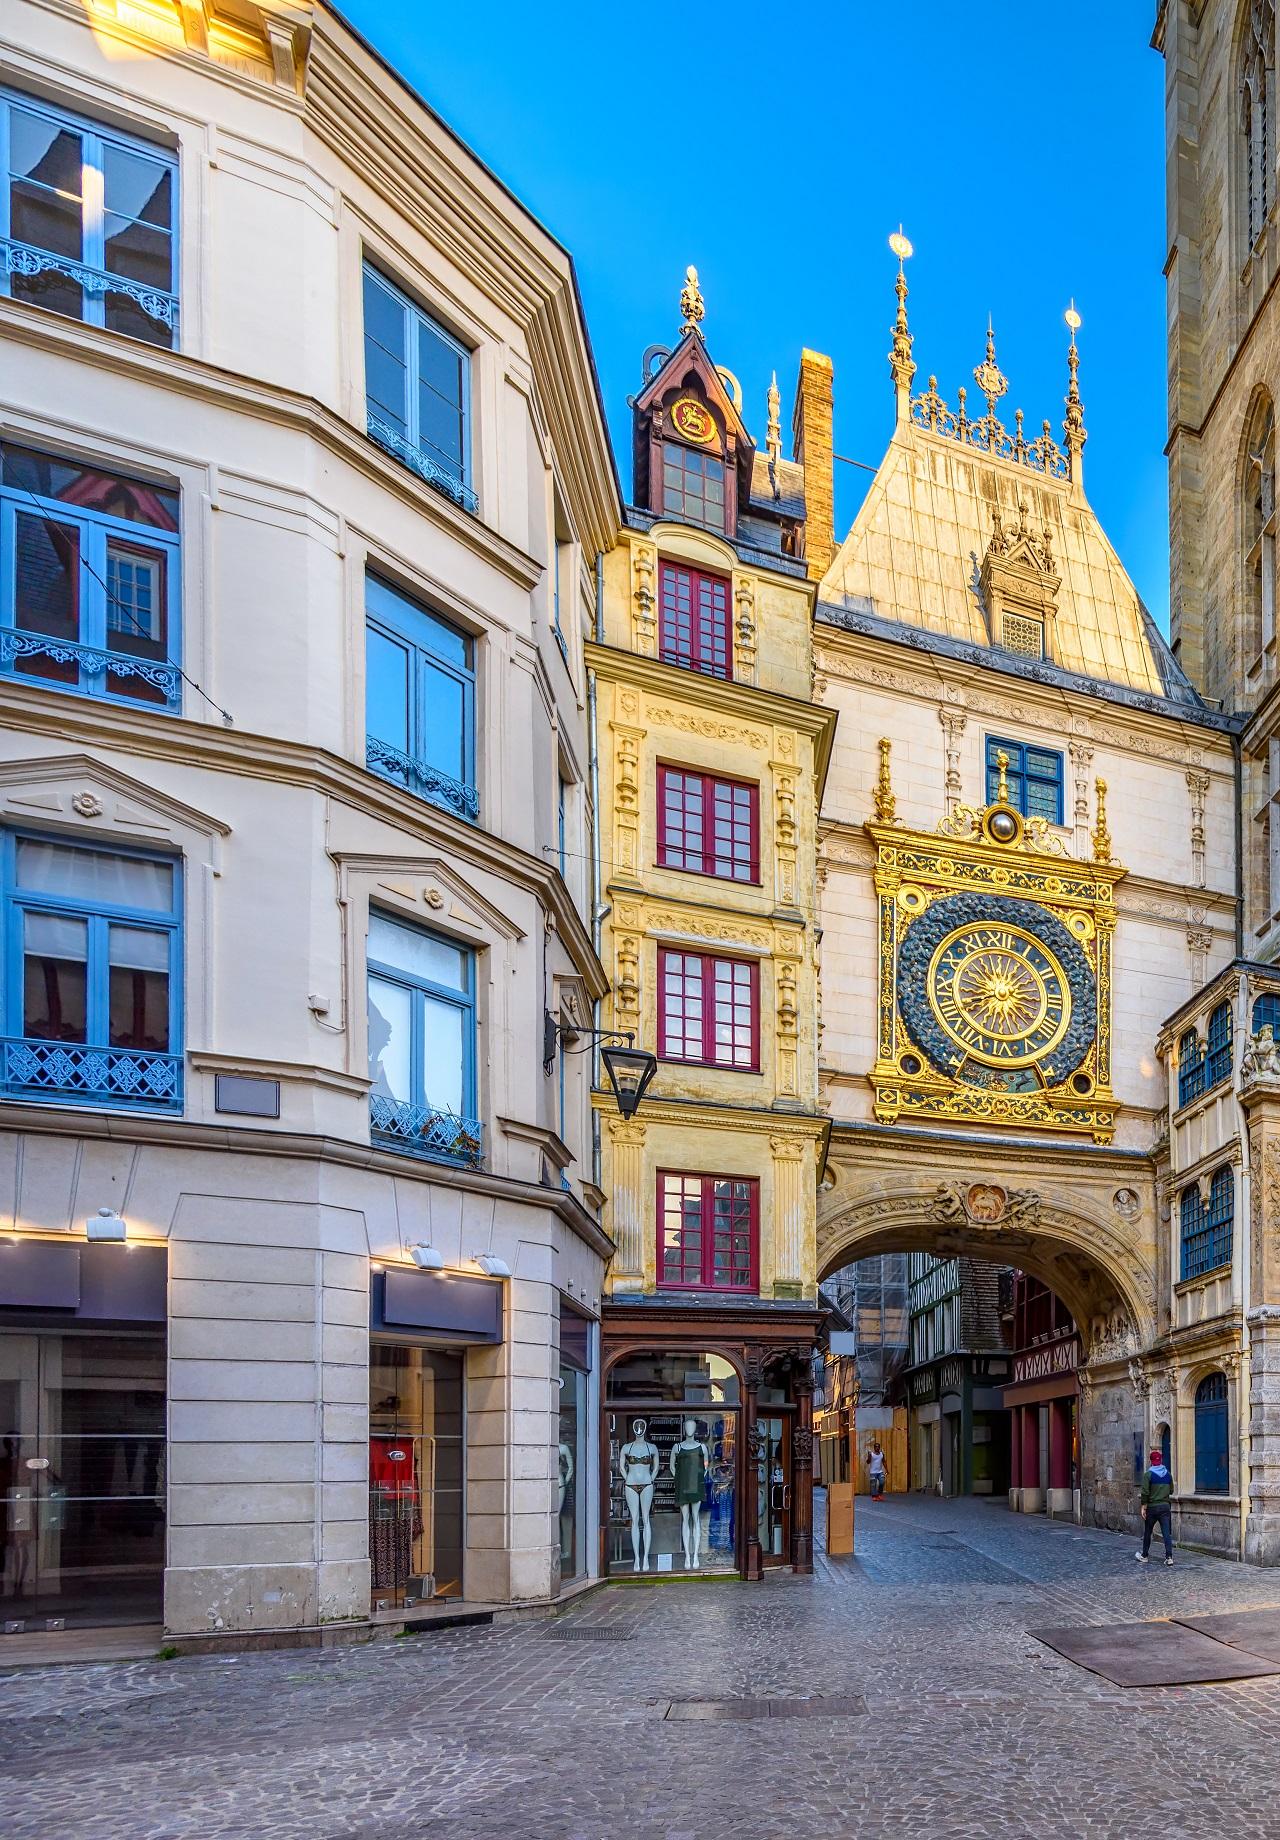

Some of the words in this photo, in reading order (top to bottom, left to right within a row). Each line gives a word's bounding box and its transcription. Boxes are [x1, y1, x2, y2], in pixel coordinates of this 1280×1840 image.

[959, 933, 983, 953] XI
[986, 931, 1012, 949] XII
[936, 975, 953, 996] IX
[1047, 993, 1062, 1010] III
[940, 1000, 962, 1032] VIII
[1038, 1016, 1059, 1039] IIII
[961, 1026, 984, 1050] VII
[1024, 1037, 1039, 1054] V
[992, 1040, 1014, 1057] VI
